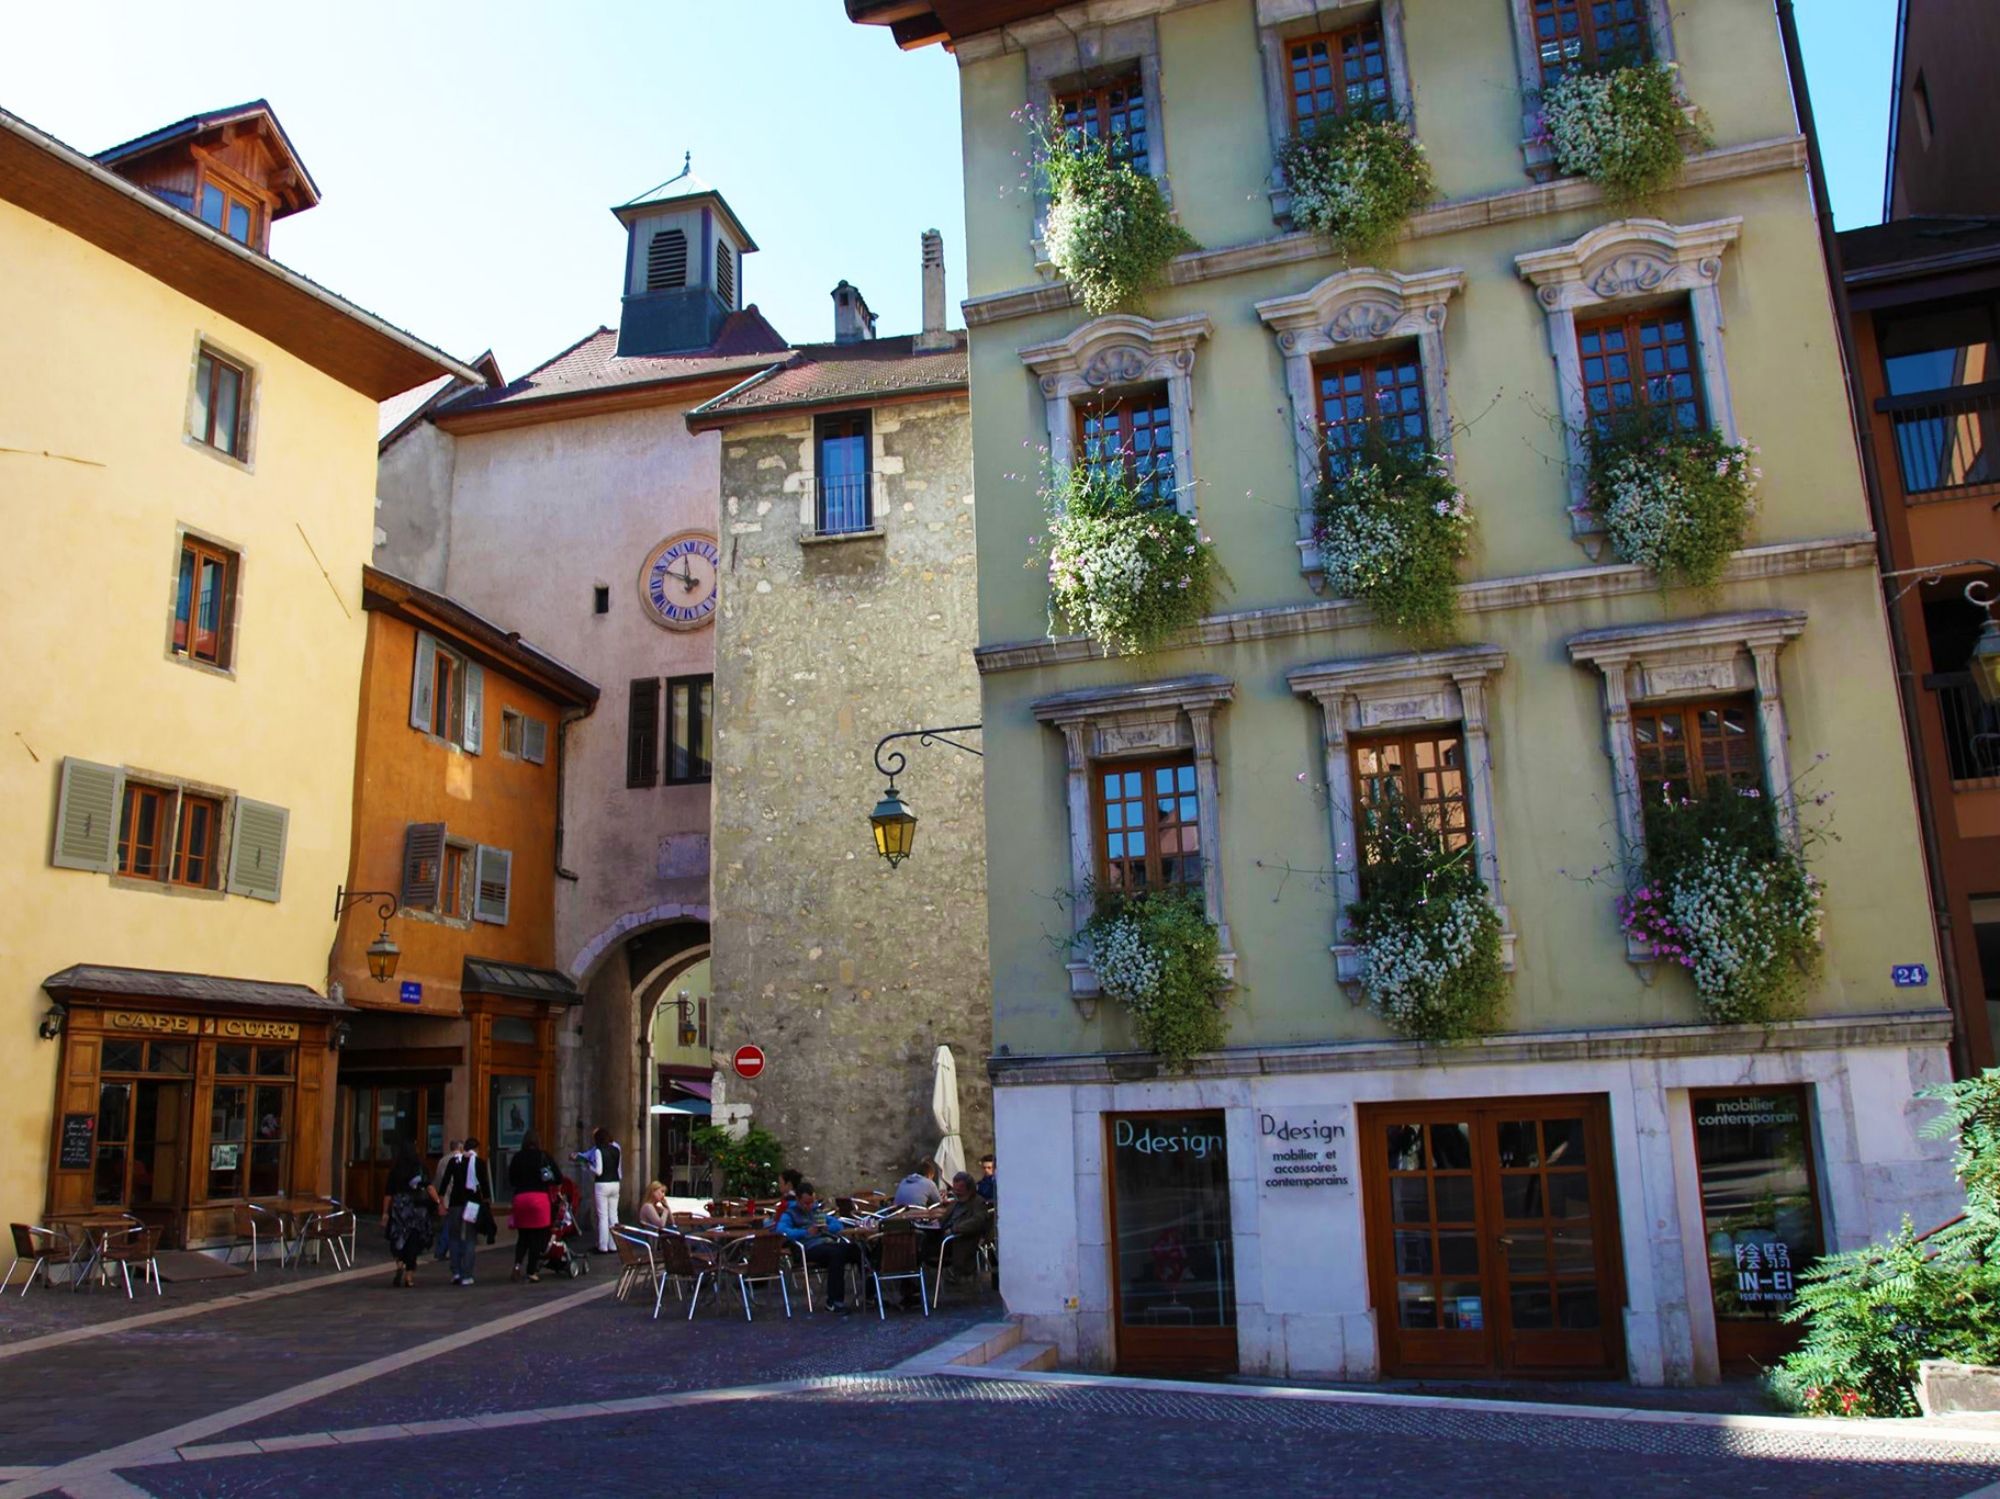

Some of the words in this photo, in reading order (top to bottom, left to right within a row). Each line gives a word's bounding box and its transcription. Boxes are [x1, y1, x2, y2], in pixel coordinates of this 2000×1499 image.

[1898, 968, 1922, 983] 24
[113, 1012, 189, 1033] CAFE
[225, 1021, 296, 1039] CURT
[1716, 1097, 1776, 1113] mobilier
[1698, 1109, 1799, 1127] contemporain
[1272, 1148, 1318, 1161] mobilier
[1326, 1149, 1337, 1160] et
[1274, 1161, 1338, 1174] accessoires
[1265, 1174, 1349, 1188] contemporains
[1738, 1271, 1793, 1291] IN-EI
